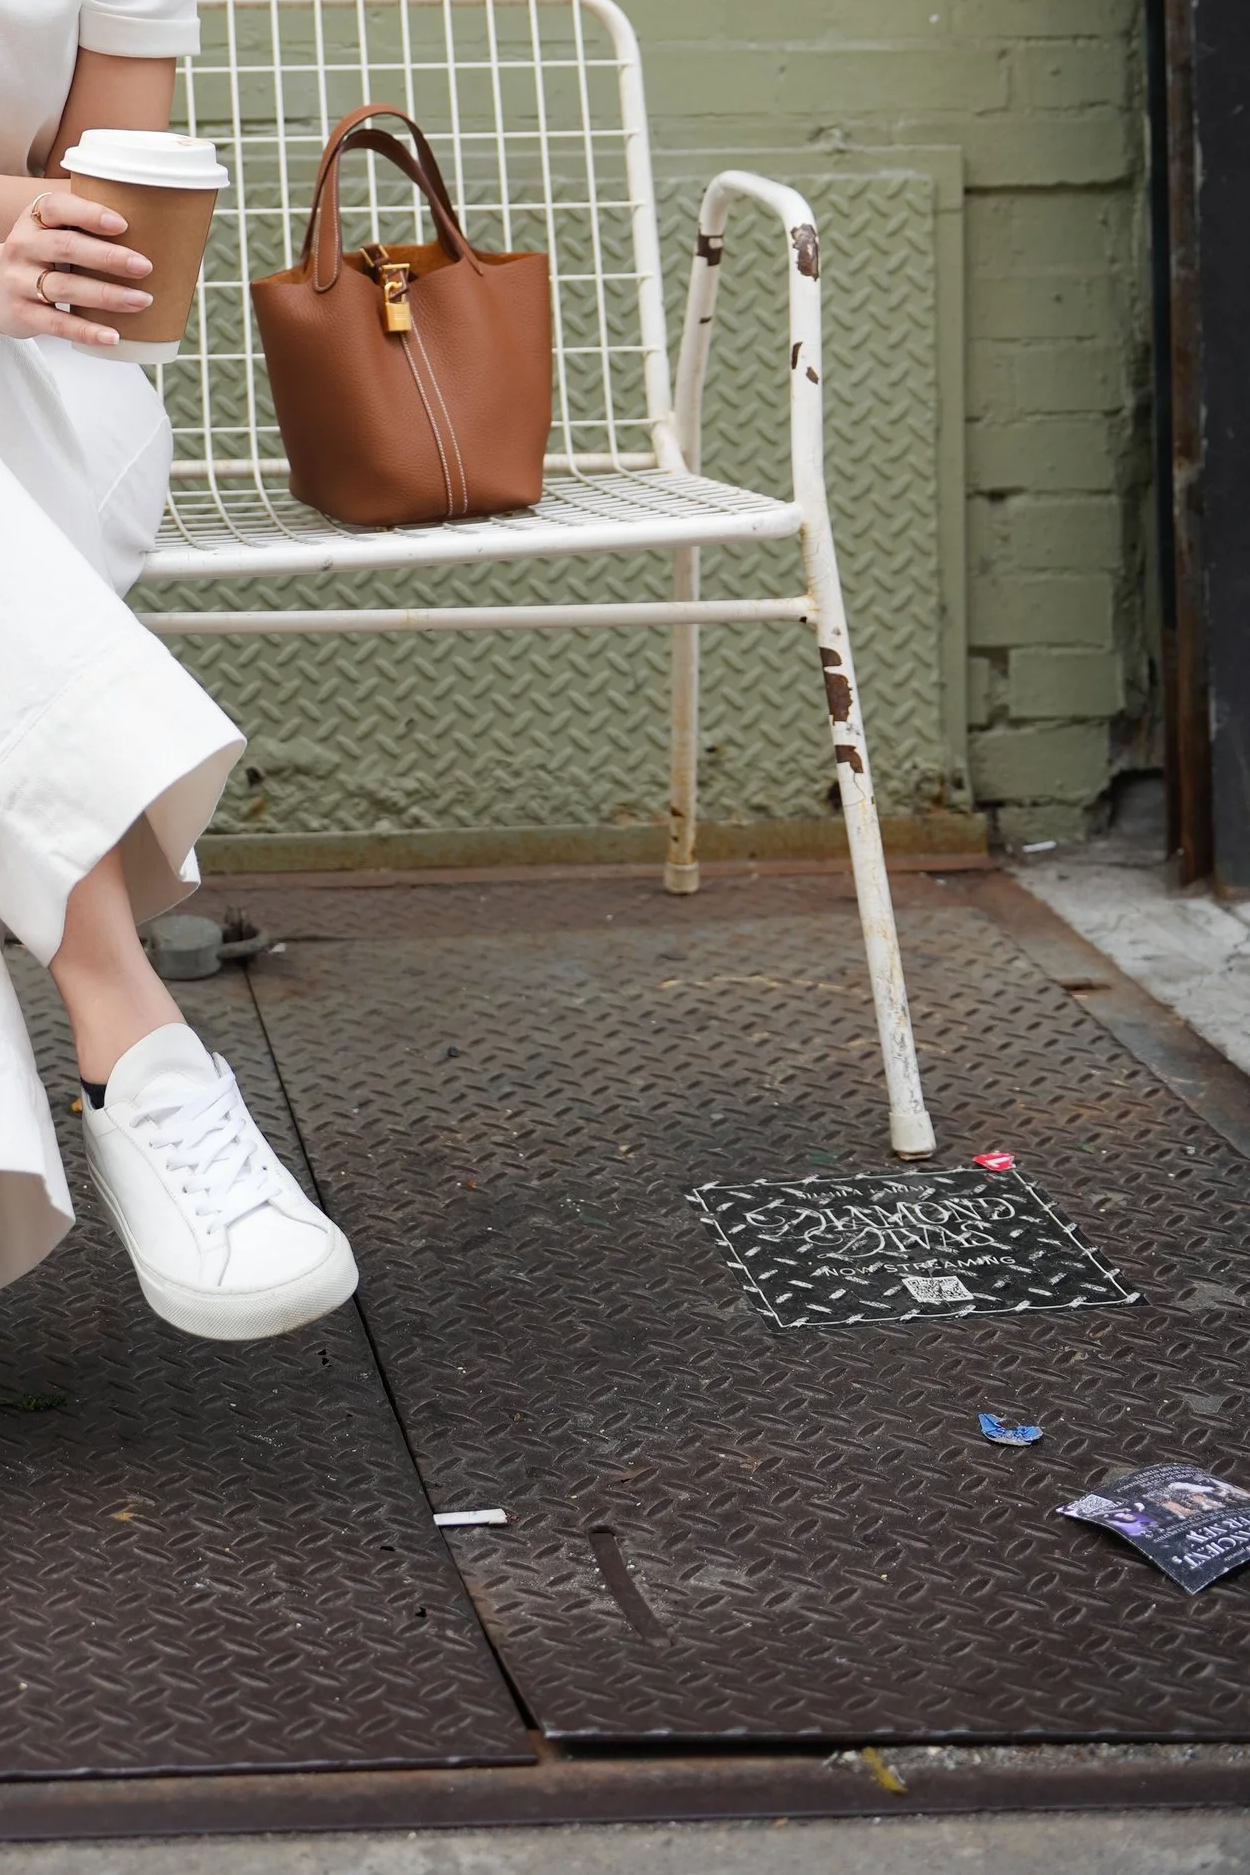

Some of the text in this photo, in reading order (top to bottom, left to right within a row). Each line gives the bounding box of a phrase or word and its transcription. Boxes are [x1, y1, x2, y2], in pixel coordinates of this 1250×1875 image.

[745, 1197, 1016, 1239] DIAMOND
[805, 1222, 995, 1259] DIVAS
[824, 1255, 1017, 1277] NOW STREAMING
